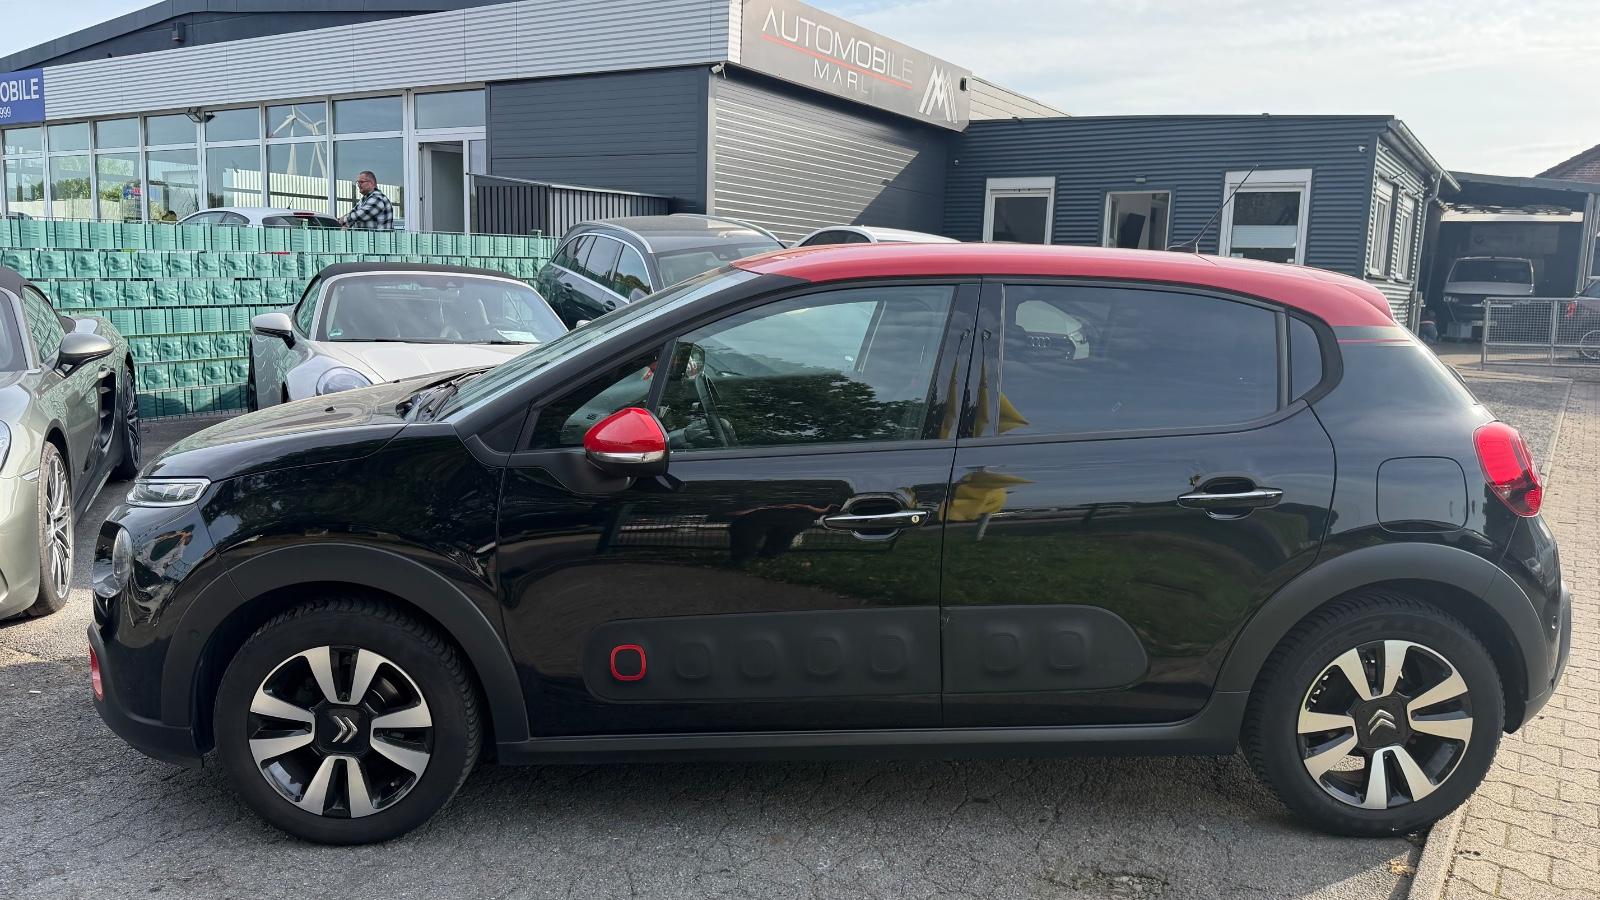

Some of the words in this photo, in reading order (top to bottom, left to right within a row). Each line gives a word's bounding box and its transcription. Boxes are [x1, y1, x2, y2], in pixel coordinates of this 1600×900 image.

[762, 5, 914, 84] AUTOMOBILE
[0, 78, 39, 102] OBILE
[814, 58, 869, 94] MARL
